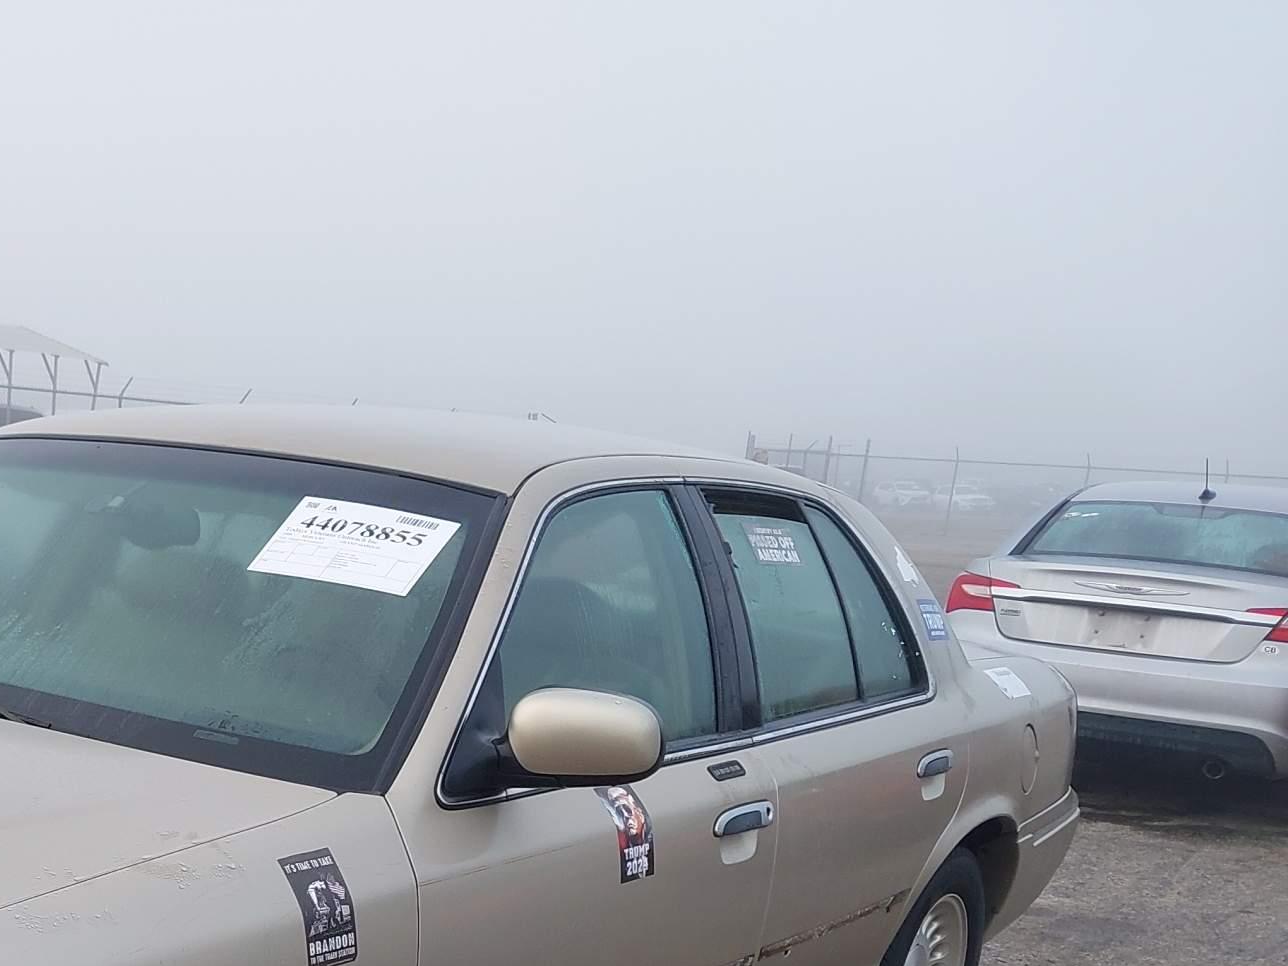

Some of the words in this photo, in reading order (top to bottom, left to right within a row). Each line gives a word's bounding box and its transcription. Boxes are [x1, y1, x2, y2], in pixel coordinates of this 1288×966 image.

[301, 515, 428, 547] 44078855
[778, 536, 795, 550] OFF
[757, 548, 801, 563] AMERICAN
[623, 843, 650, 861] TRUMP
[309, 932, 355, 957] BRANDON
